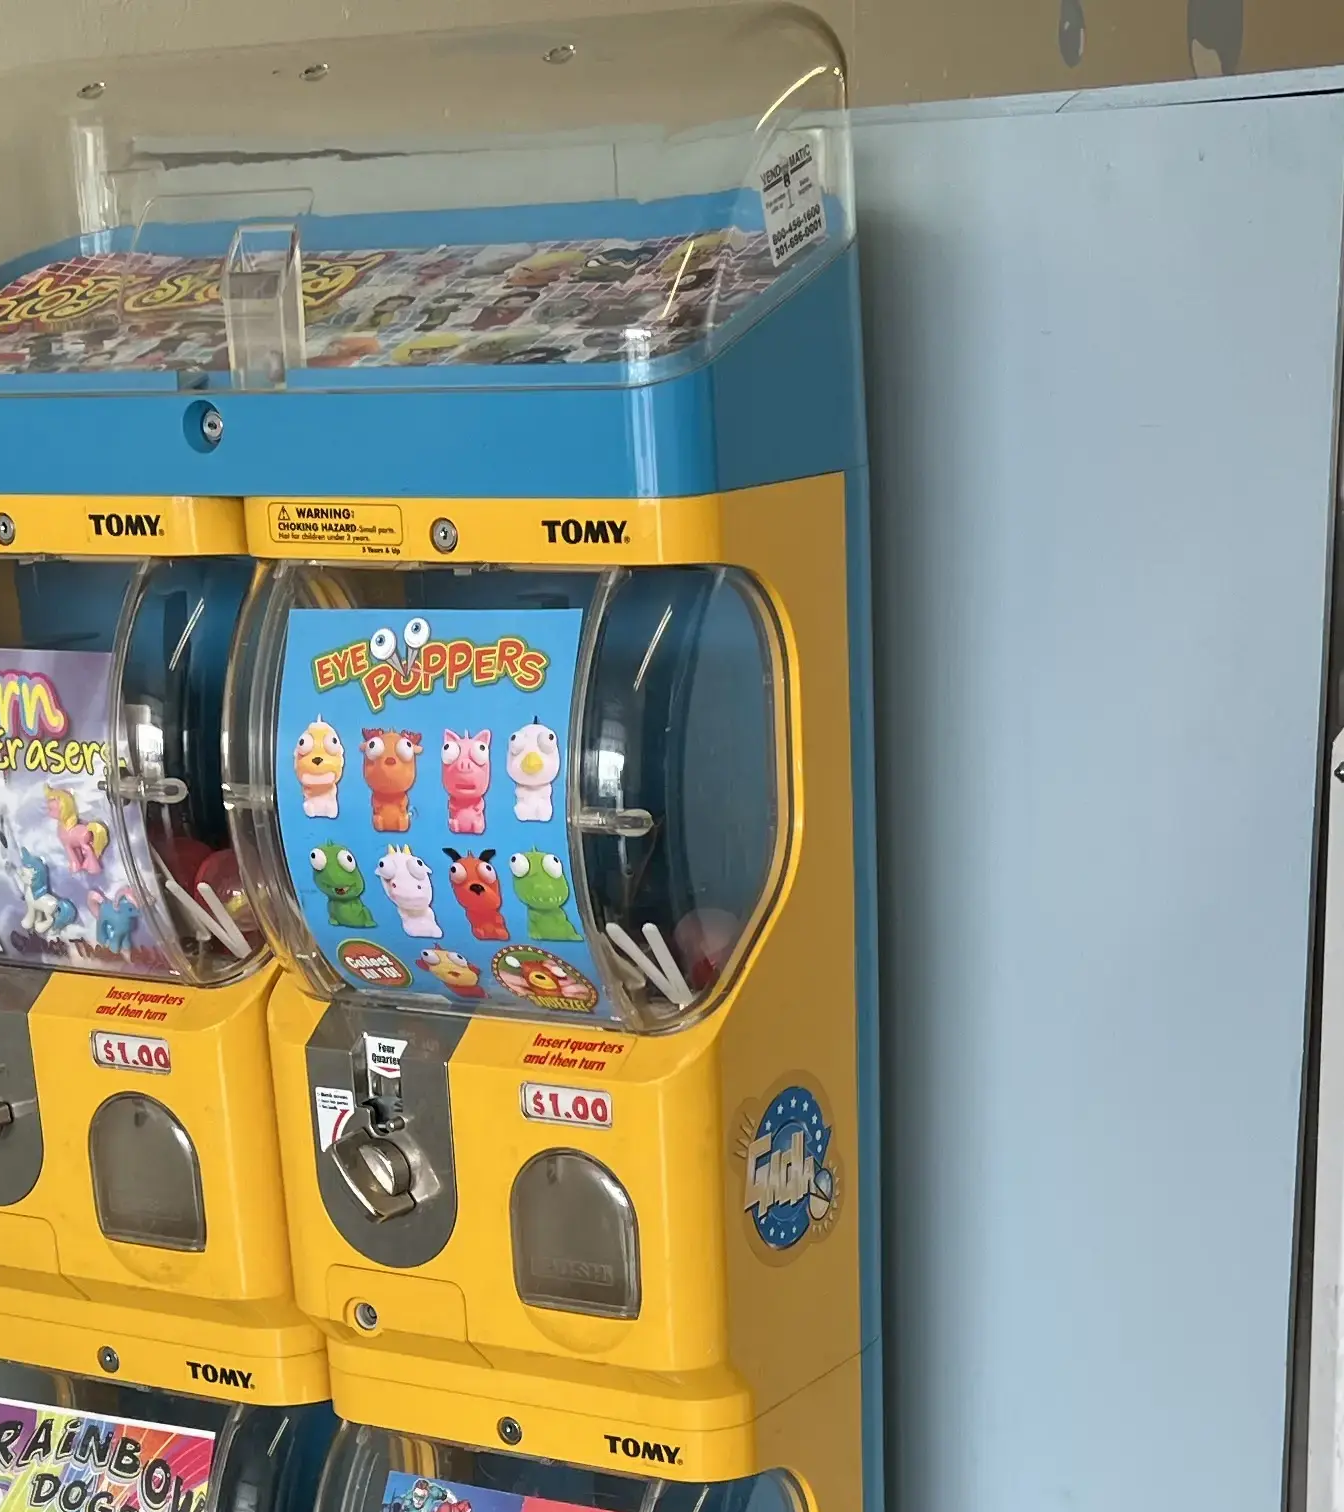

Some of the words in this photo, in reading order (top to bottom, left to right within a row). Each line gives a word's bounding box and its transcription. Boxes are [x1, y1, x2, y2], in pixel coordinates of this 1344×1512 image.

[789, 144, 811, 167] MATIC
[295, 507, 354, 519] WARNING:
[89, 514, 161, 537] TOMY
[278, 522, 318, 531] CHOKING
[541, 520, 628, 545] TOMY
[315, 642, 368, 688] EYE
[344, 953, 392, 969] Collect
[360, 967, 383, 980] All
[383, 966, 403, 980] 10!
[106, 986, 137, 1005] Insert
[135, 990, 185, 1008] quarters
[96, 1004, 117, 1018] and
[118, 1005, 143, 1019] then
[144, 1008, 168, 1021] turn
[103, 1039, 170, 1069] $1.00
[377, 1042, 395, 1054] Four
[532, 1032, 568, 1050] Insert
[567, 1038, 625, 1056] quarters
[523, 1050, 548, 1067] and
[548, 1052, 576, 1069] then
[577, 1055, 606, 1072] turn
[531, 1090, 609, 1123] $1.00
[185, 1361, 251, 1389] TOMY
[604, 1434, 680, 1466] TOMY
